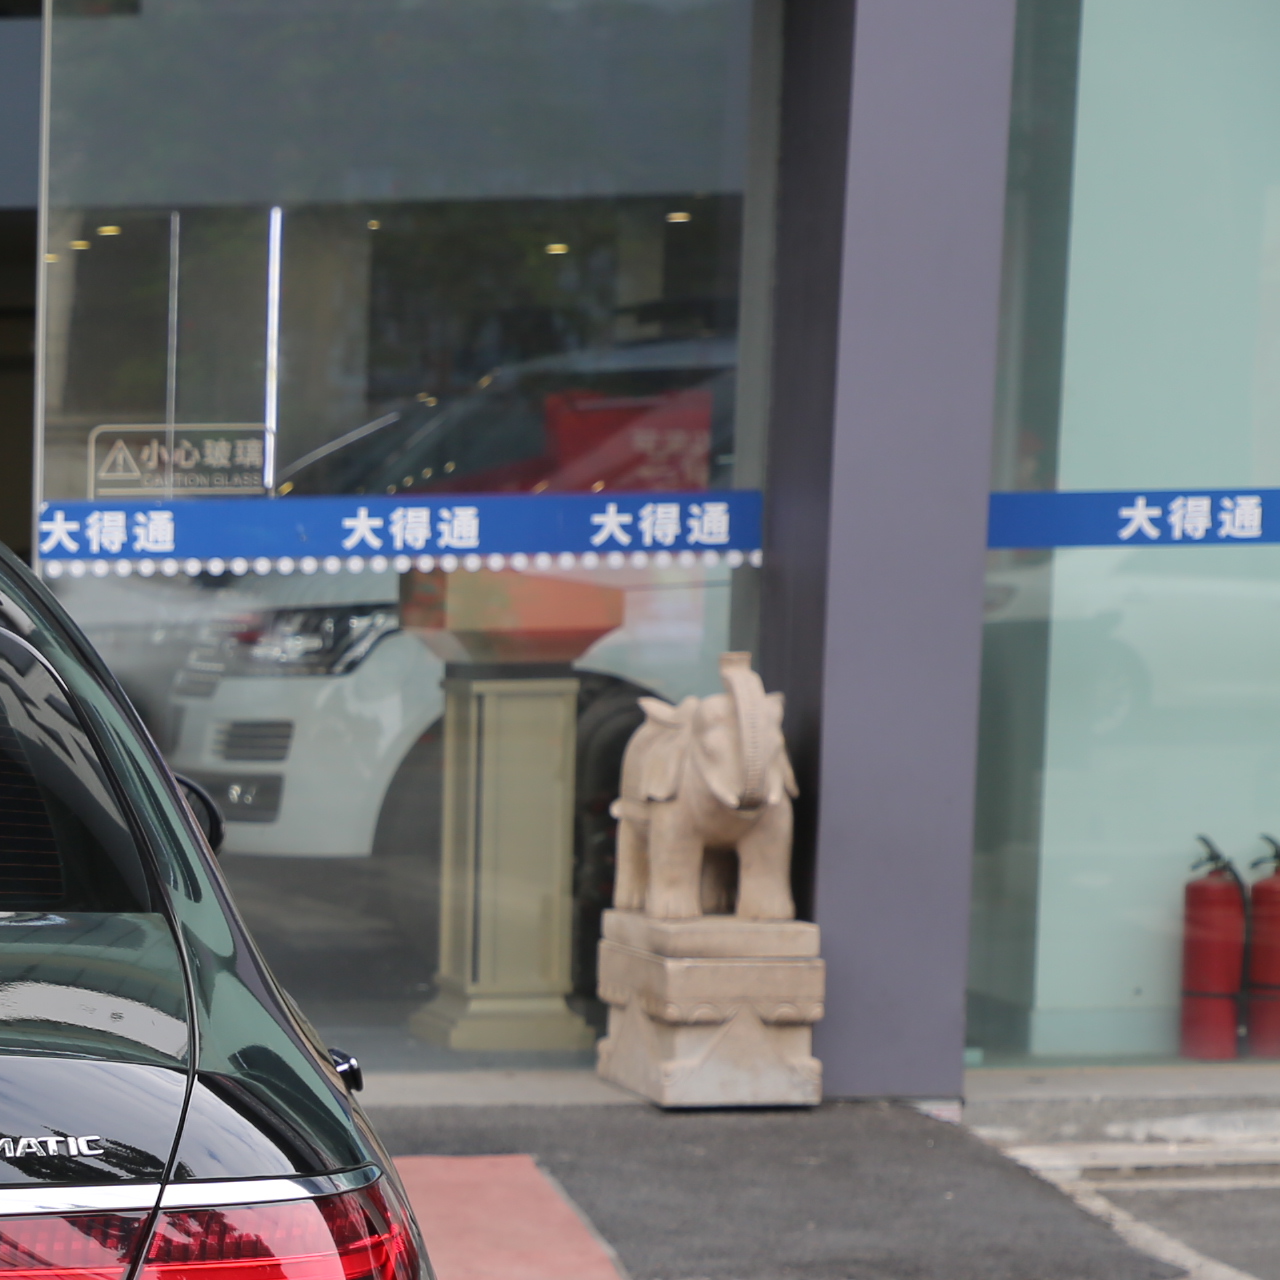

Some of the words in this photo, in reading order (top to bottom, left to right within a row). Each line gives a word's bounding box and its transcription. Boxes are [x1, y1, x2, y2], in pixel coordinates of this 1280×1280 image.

[140, 437, 263, 469] 小心玻璃
[212, 473, 262, 486] GLASS
[39, 510, 175, 554] 大得通
[342, 506, 479, 550] 大得通
[590, 502, 730, 547] 大得通
[1117, 495, 1263, 541] 大得通
